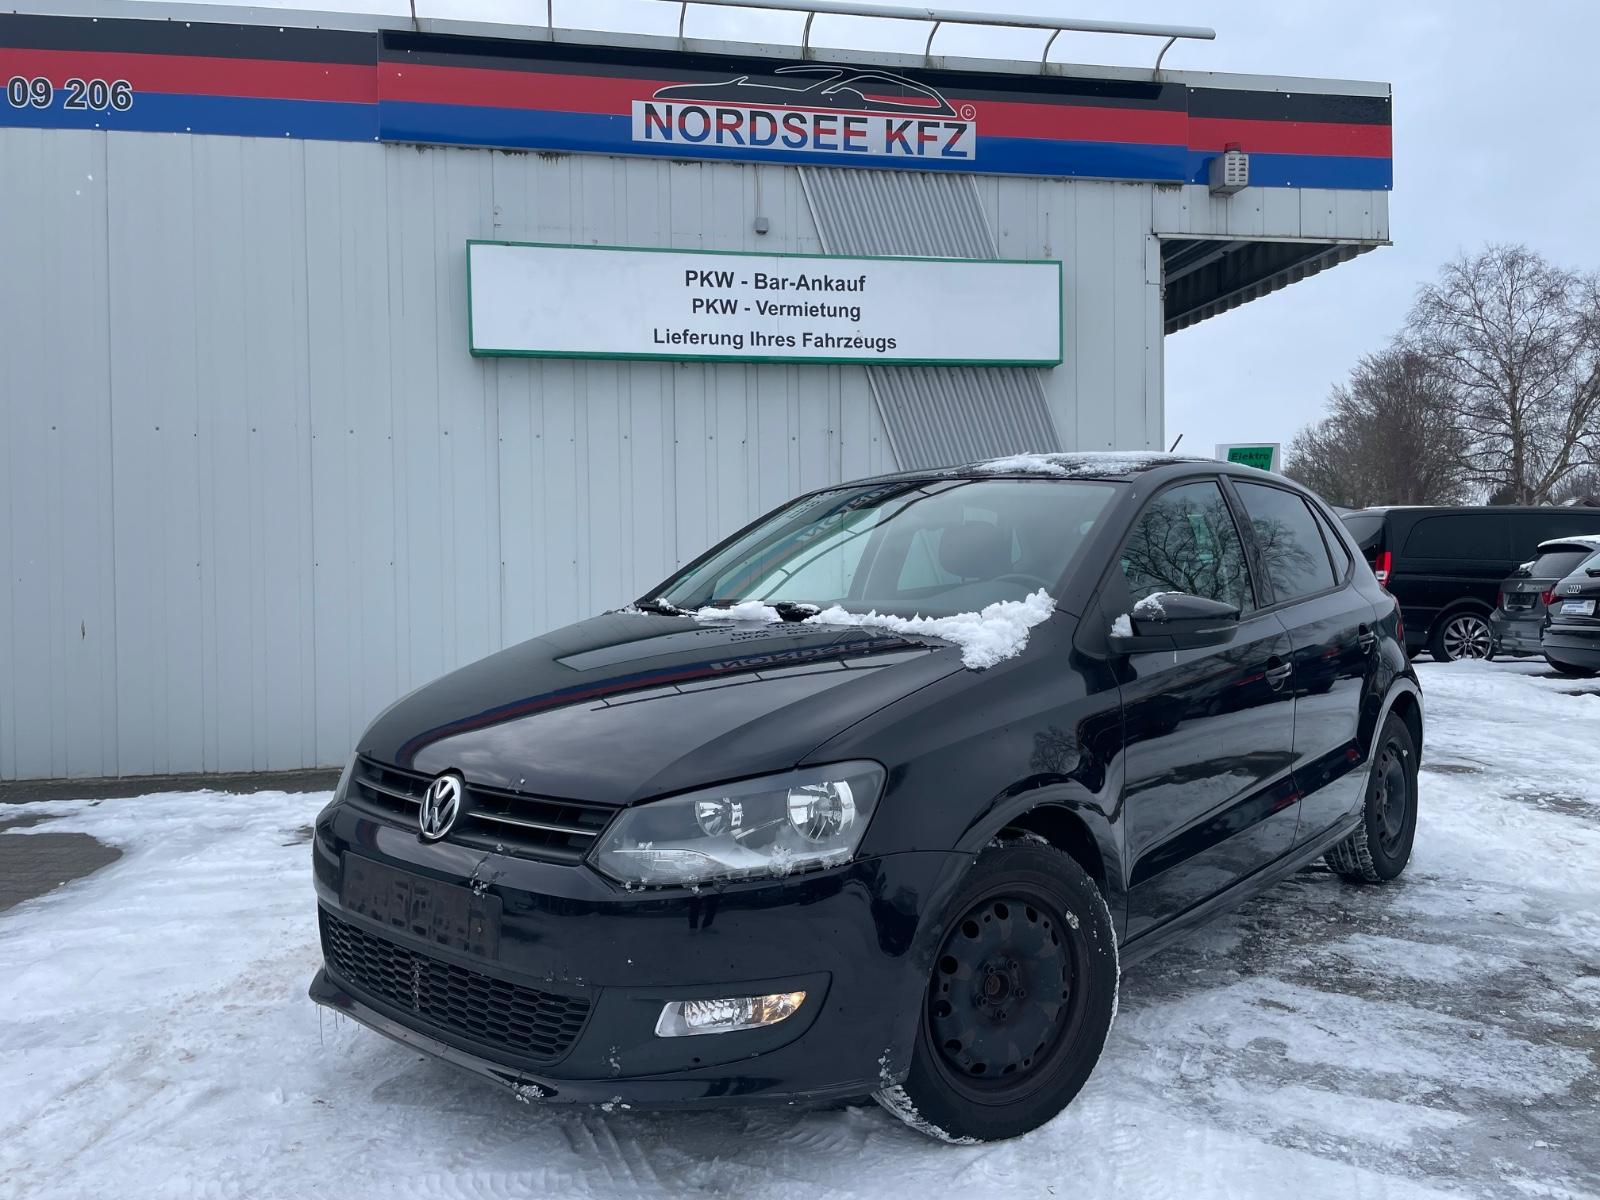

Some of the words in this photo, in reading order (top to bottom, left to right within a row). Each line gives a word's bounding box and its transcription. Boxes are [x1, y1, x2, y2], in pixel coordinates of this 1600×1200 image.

[7, 75, 53, 108] 09
[64, 77, 133, 111] 206
[644, 102, 868, 152] NORDSEE
[885, 118, 967, 157] KFZ
[685, 269, 735, 288] PKW
[754, 272, 866, 292] Bar-Ankauf
[692, 298, 738, 314] PKW
[755, 300, 861, 322] Vermietung
[653, 328, 743, 349] Lieferung
[750, 331, 796, 347] Ihres
[802, 332, 897, 352] Fahrzeugs
